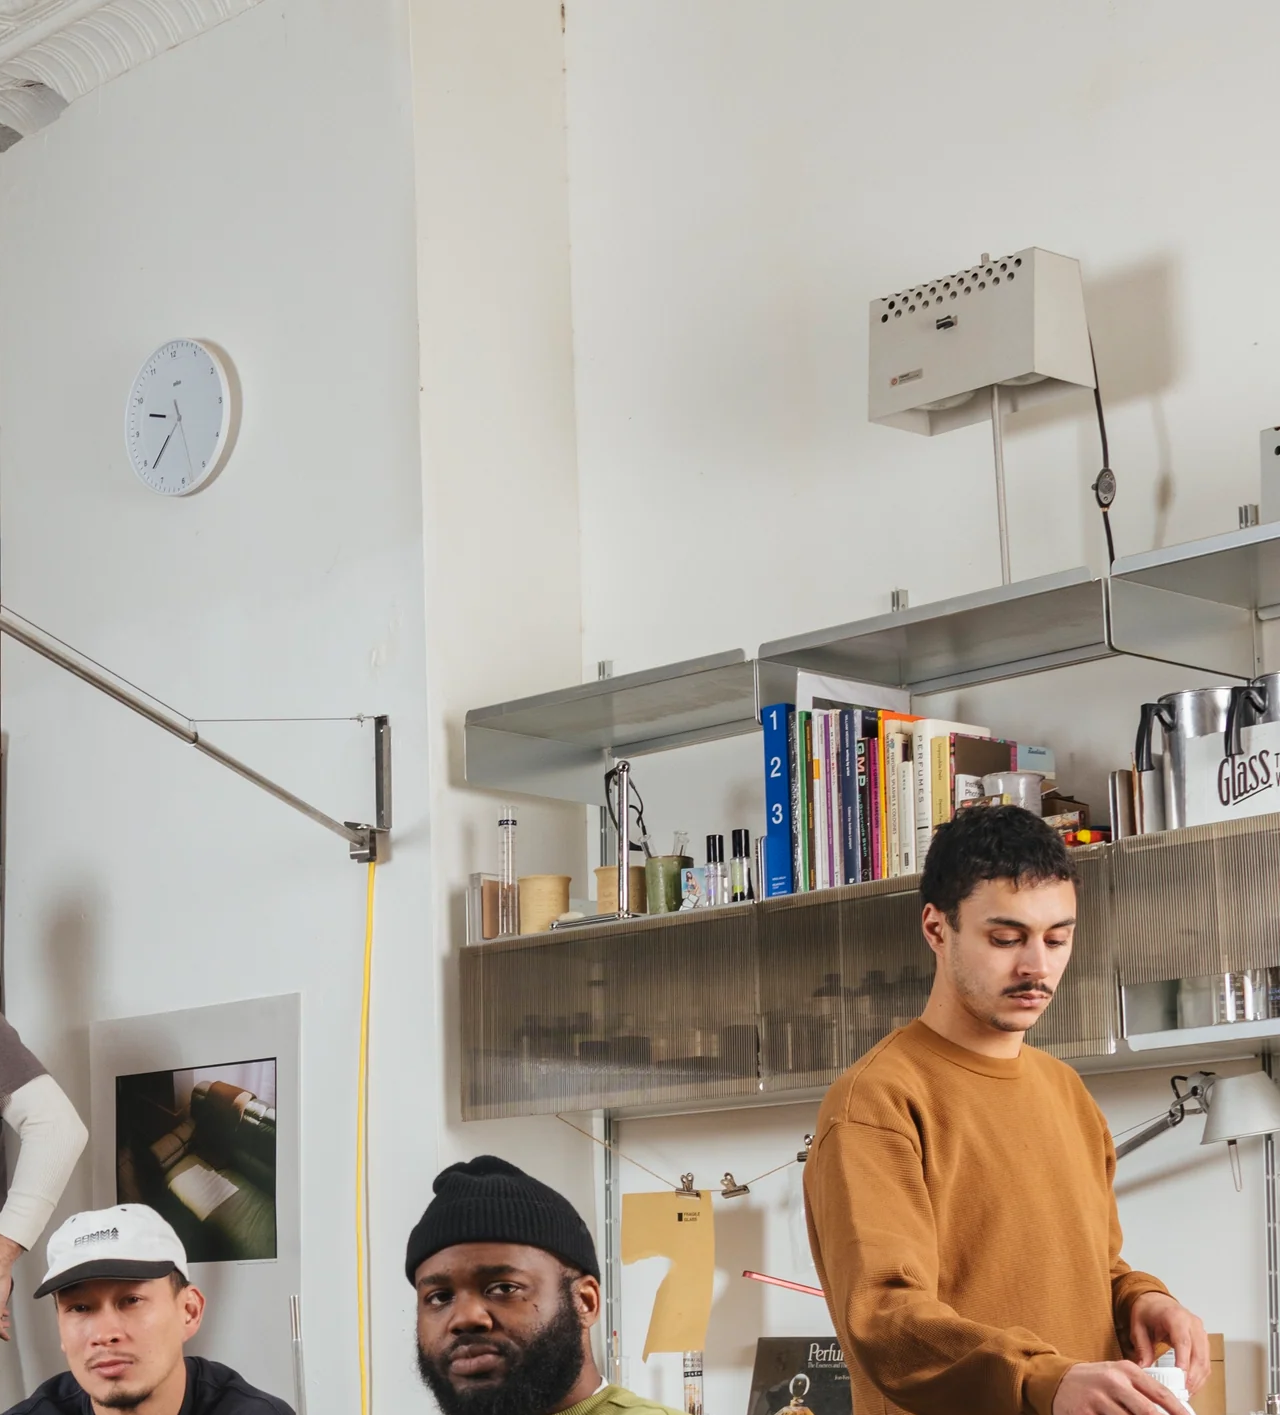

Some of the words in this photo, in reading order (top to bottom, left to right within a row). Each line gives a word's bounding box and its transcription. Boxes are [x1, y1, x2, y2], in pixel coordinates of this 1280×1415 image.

[769, 710, 777, 730] 1
[770, 756, 781, 778] 2
[857, 742, 865, 788] GMP
[917, 735, 925, 803] PERFUMES
[1218, 749, 1271, 806] Glass
[771, 803, 783, 824] 3
[808, 1343, 845, 1362] Perfu
